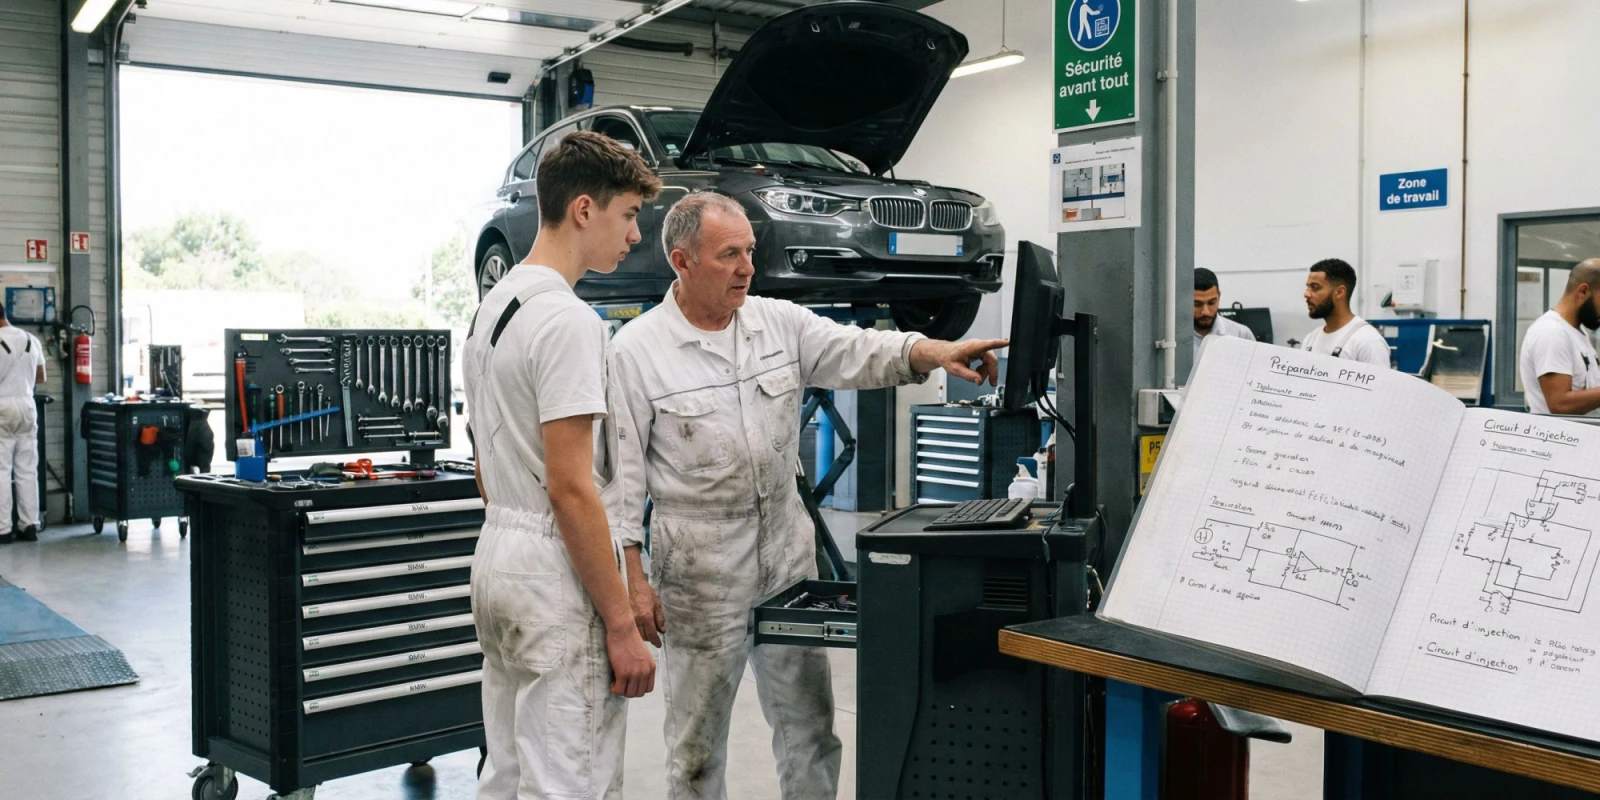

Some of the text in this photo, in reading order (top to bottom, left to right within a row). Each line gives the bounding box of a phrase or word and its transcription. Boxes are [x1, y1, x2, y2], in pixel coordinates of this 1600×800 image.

[1065, 52, 1123, 77] Sécurité
[1059, 72, 1129, 97] avant tout
[1398, 178, 1427, 189] Zone
[1386, 190, 1439, 204] de travail
[1270, 356, 1376, 385] Préparation PFMP
[1484, 419, 1580, 443] Circuit d'injection
[1462, 621, 1520, 641] d'injection
[1426, 642, 1459, 656] Circuit
[1465, 651, 1518, 671] d'injection
